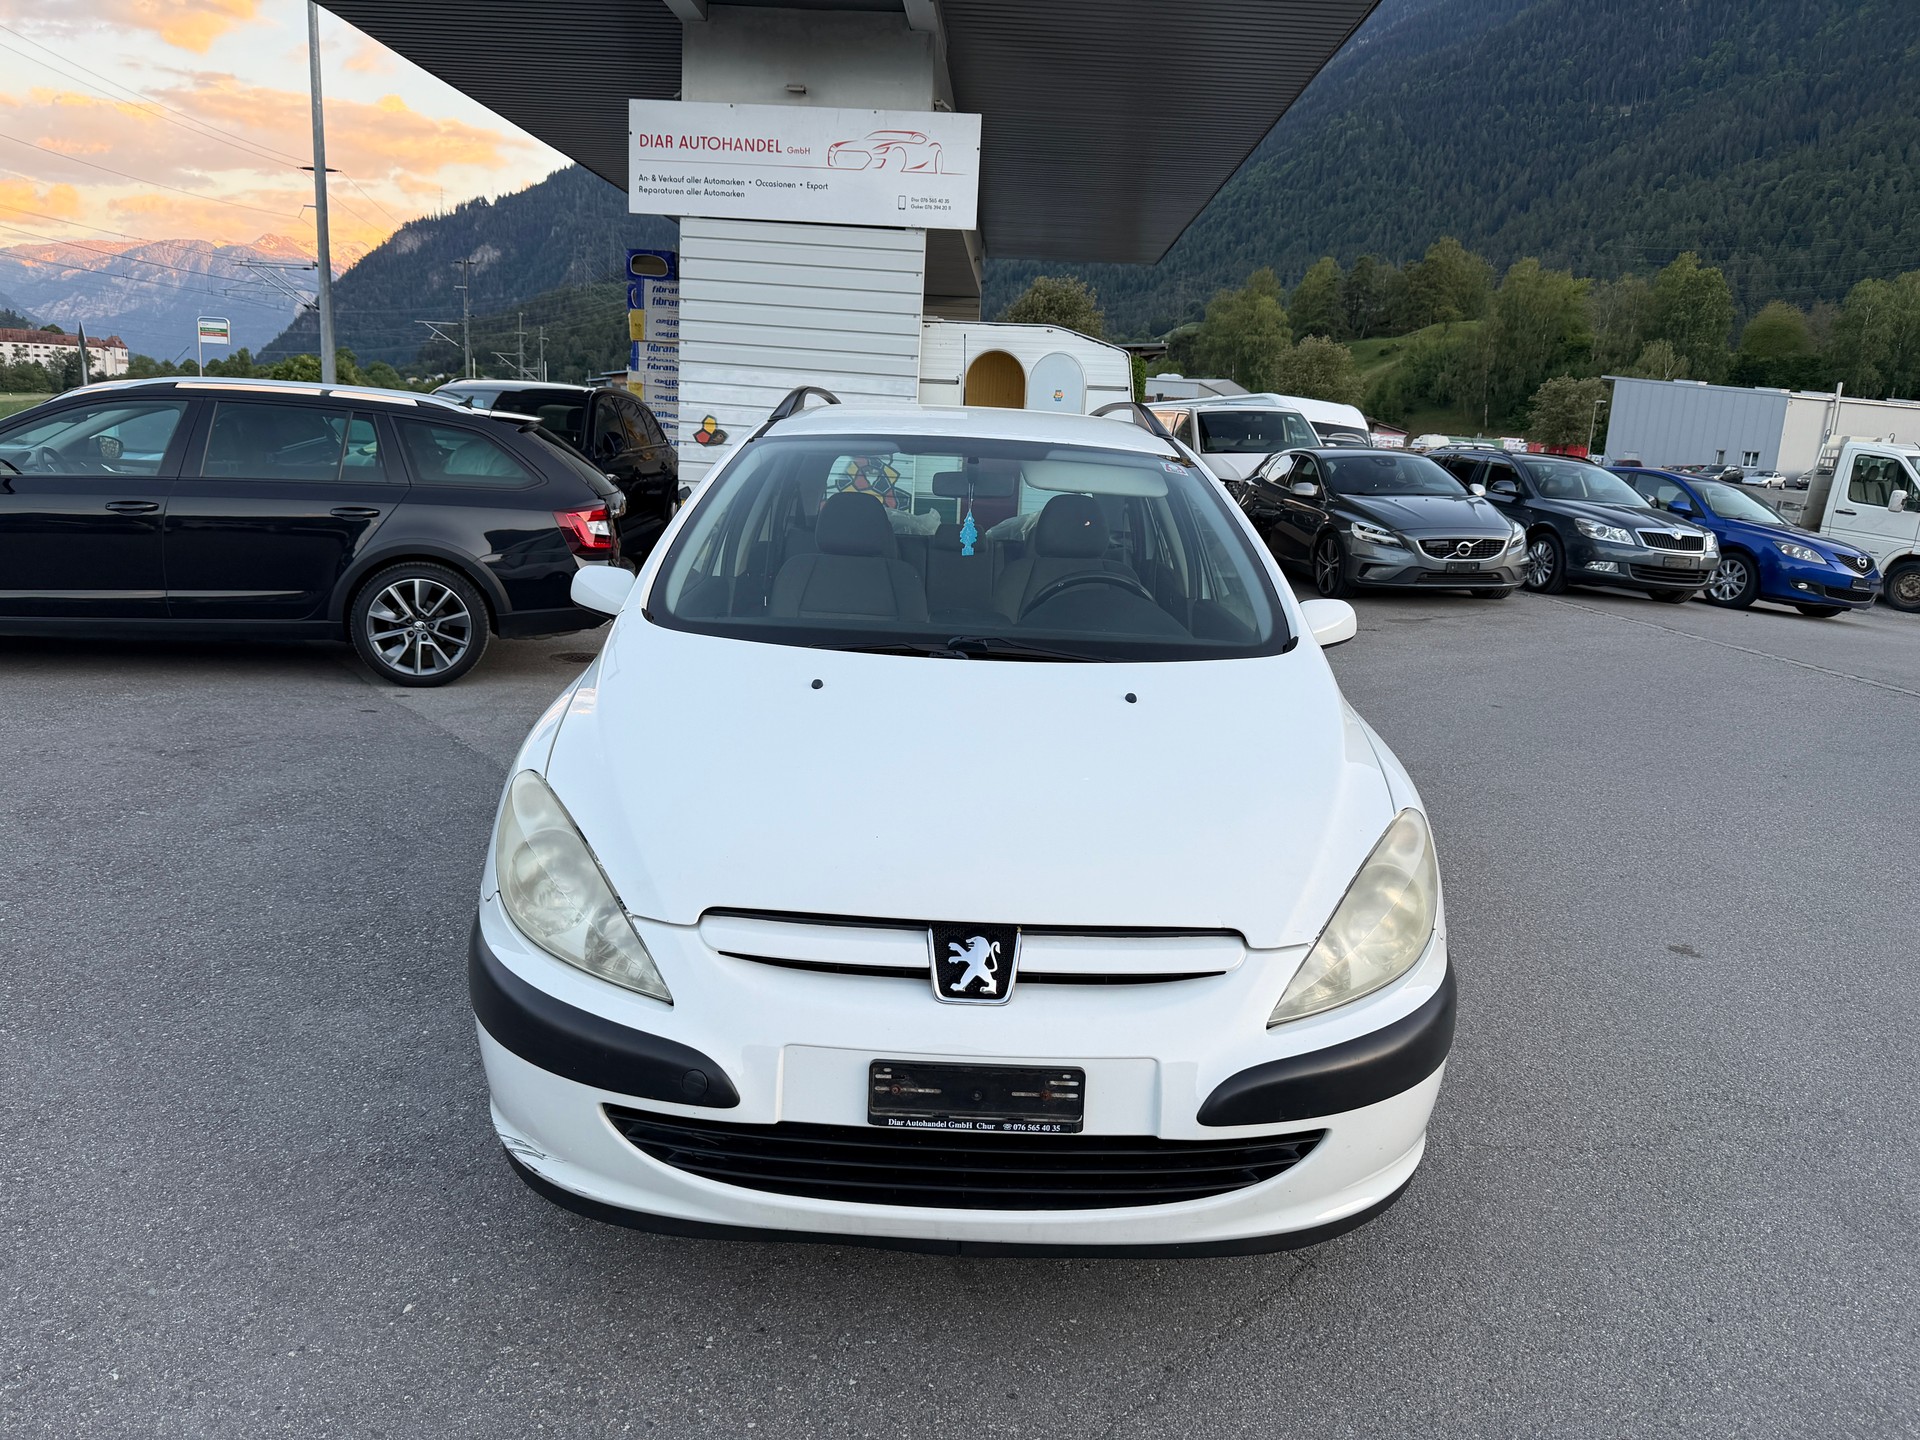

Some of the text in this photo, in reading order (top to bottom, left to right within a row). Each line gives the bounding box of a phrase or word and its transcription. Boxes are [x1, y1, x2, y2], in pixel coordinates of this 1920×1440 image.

[639, 133, 811, 155] DIAR AUTOHANDEL GmbH
[638, 174, 649, 182] An-
[658, 175, 685, 183] Verkauf
[686, 176, 702, 184] aller
[703, 177, 745, 186] Automarken
[755, 179, 796, 188] Occasionen
[806, 182, 828, 191] Export
[638, 186, 745, 198] Reparaturen aller Automarken
[888, 1118, 904, 1126] Diar
[905, 1119, 947, 1128] Autohandel
[948, 1121, 973, 1129] GmbH
[976, 1122, 996, 1130] Chur
